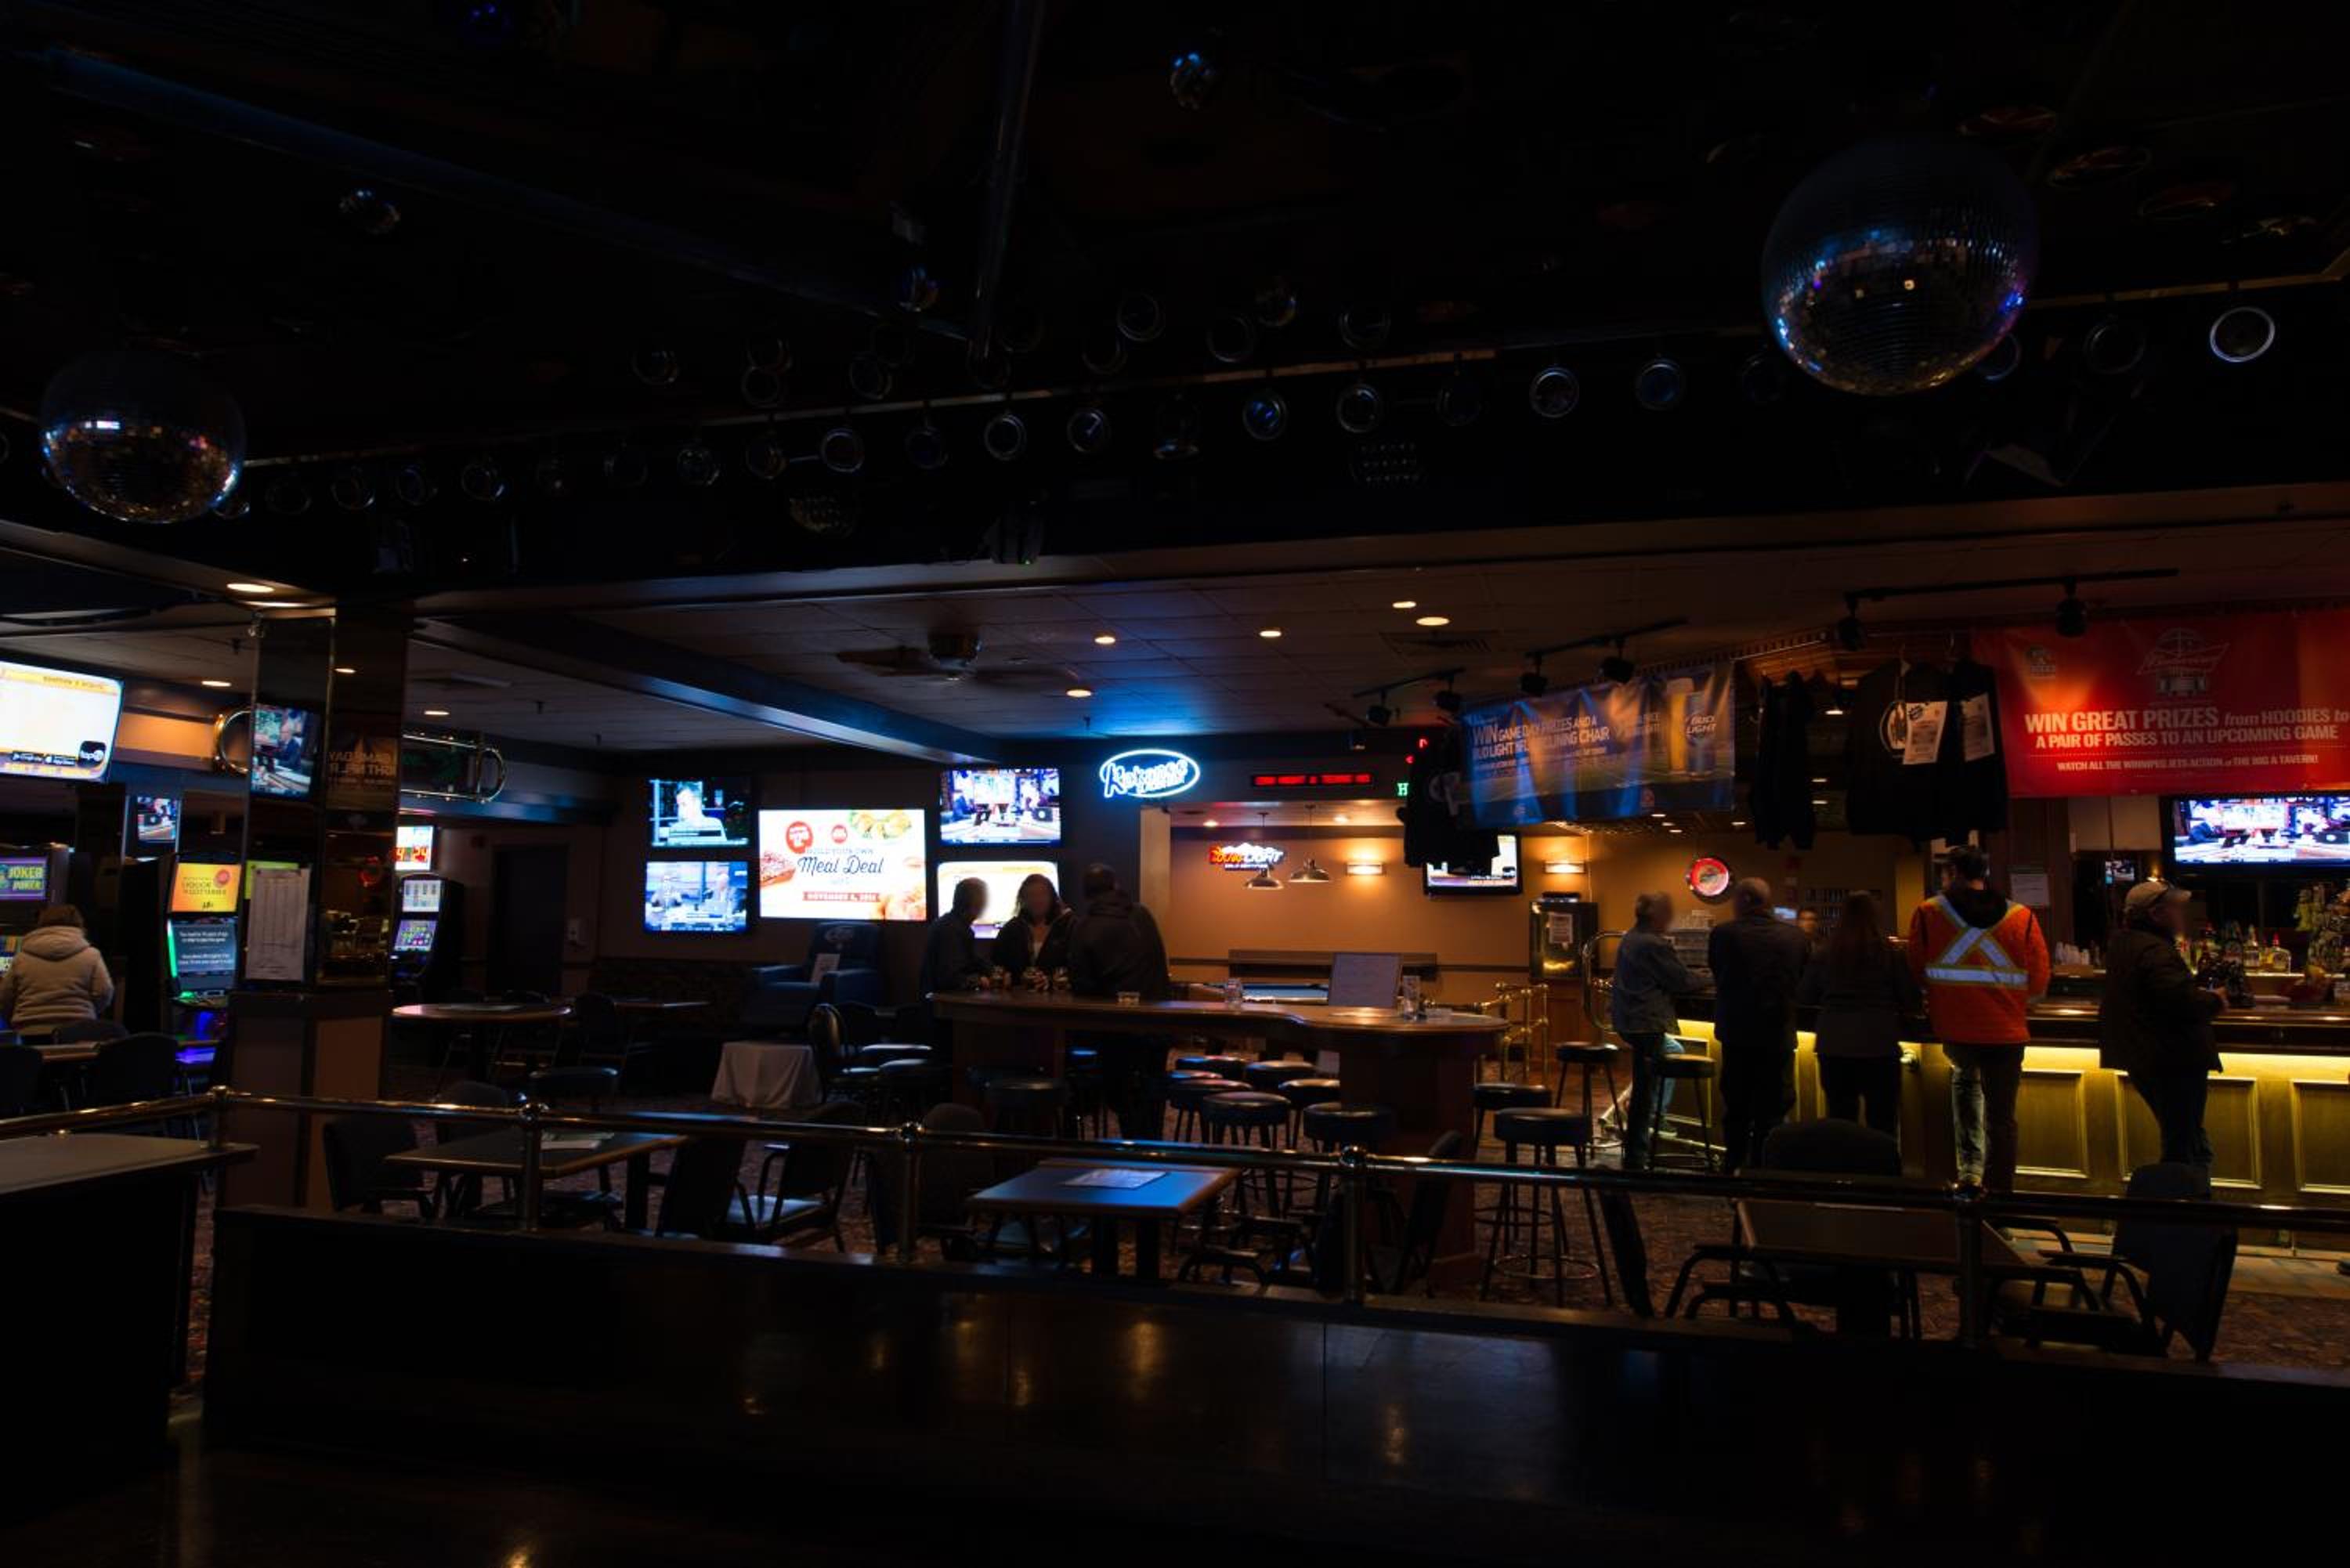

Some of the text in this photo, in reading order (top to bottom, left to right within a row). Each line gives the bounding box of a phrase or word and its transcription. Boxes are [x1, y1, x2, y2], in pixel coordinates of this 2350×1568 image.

[1686, 723, 1717, 737] LIGHT
[1689, 714, 1716, 726] BUD
[2025, 714, 2068, 733] WIN
[2071, 710, 2138, 732] GREAT
[2142, 706, 2218, 730] PRIZES
[2225, 712, 2260, 726] from
[2261, 708, 2330, 724] HOODIES
[1472, 723, 1499, 746] WIN
[1499, 726, 1523, 742] GAME
[1488, 741, 1515, 759] LIGHT
[1578, 726, 1611, 744] CHAIR
[2036, 725, 2339, 749] A PAIR OF PASSES TO AN UPCOMING GAME
[2056, 761, 2088, 771] WATCH
[2088, 761, 2104, 771] ALL
[797, 854, 885, 876] Meal Deal
